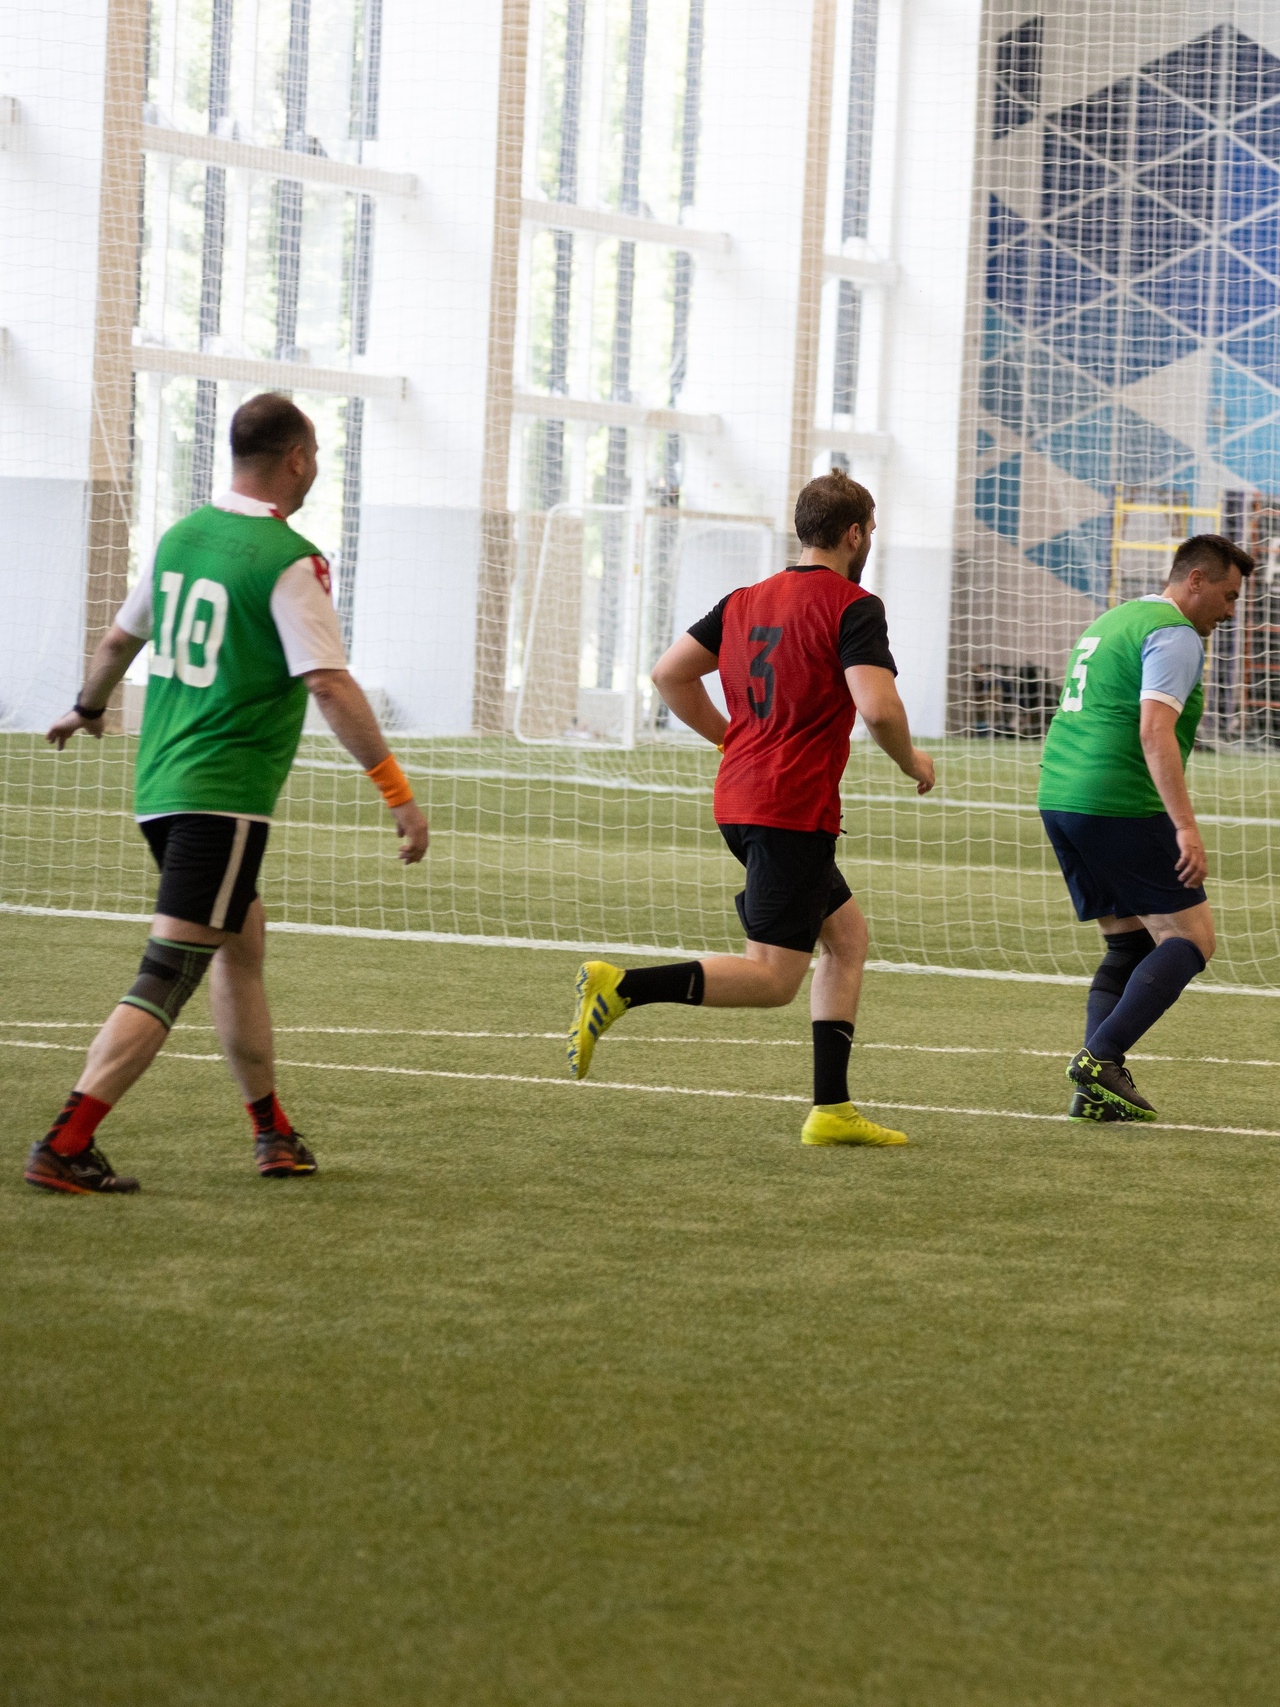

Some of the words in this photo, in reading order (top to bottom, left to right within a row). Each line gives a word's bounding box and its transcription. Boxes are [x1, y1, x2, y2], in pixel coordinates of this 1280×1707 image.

[149, 571, 229, 688] 10
[747, 626, 783, 719] 3
[1061, 637, 1102, 712] 3
